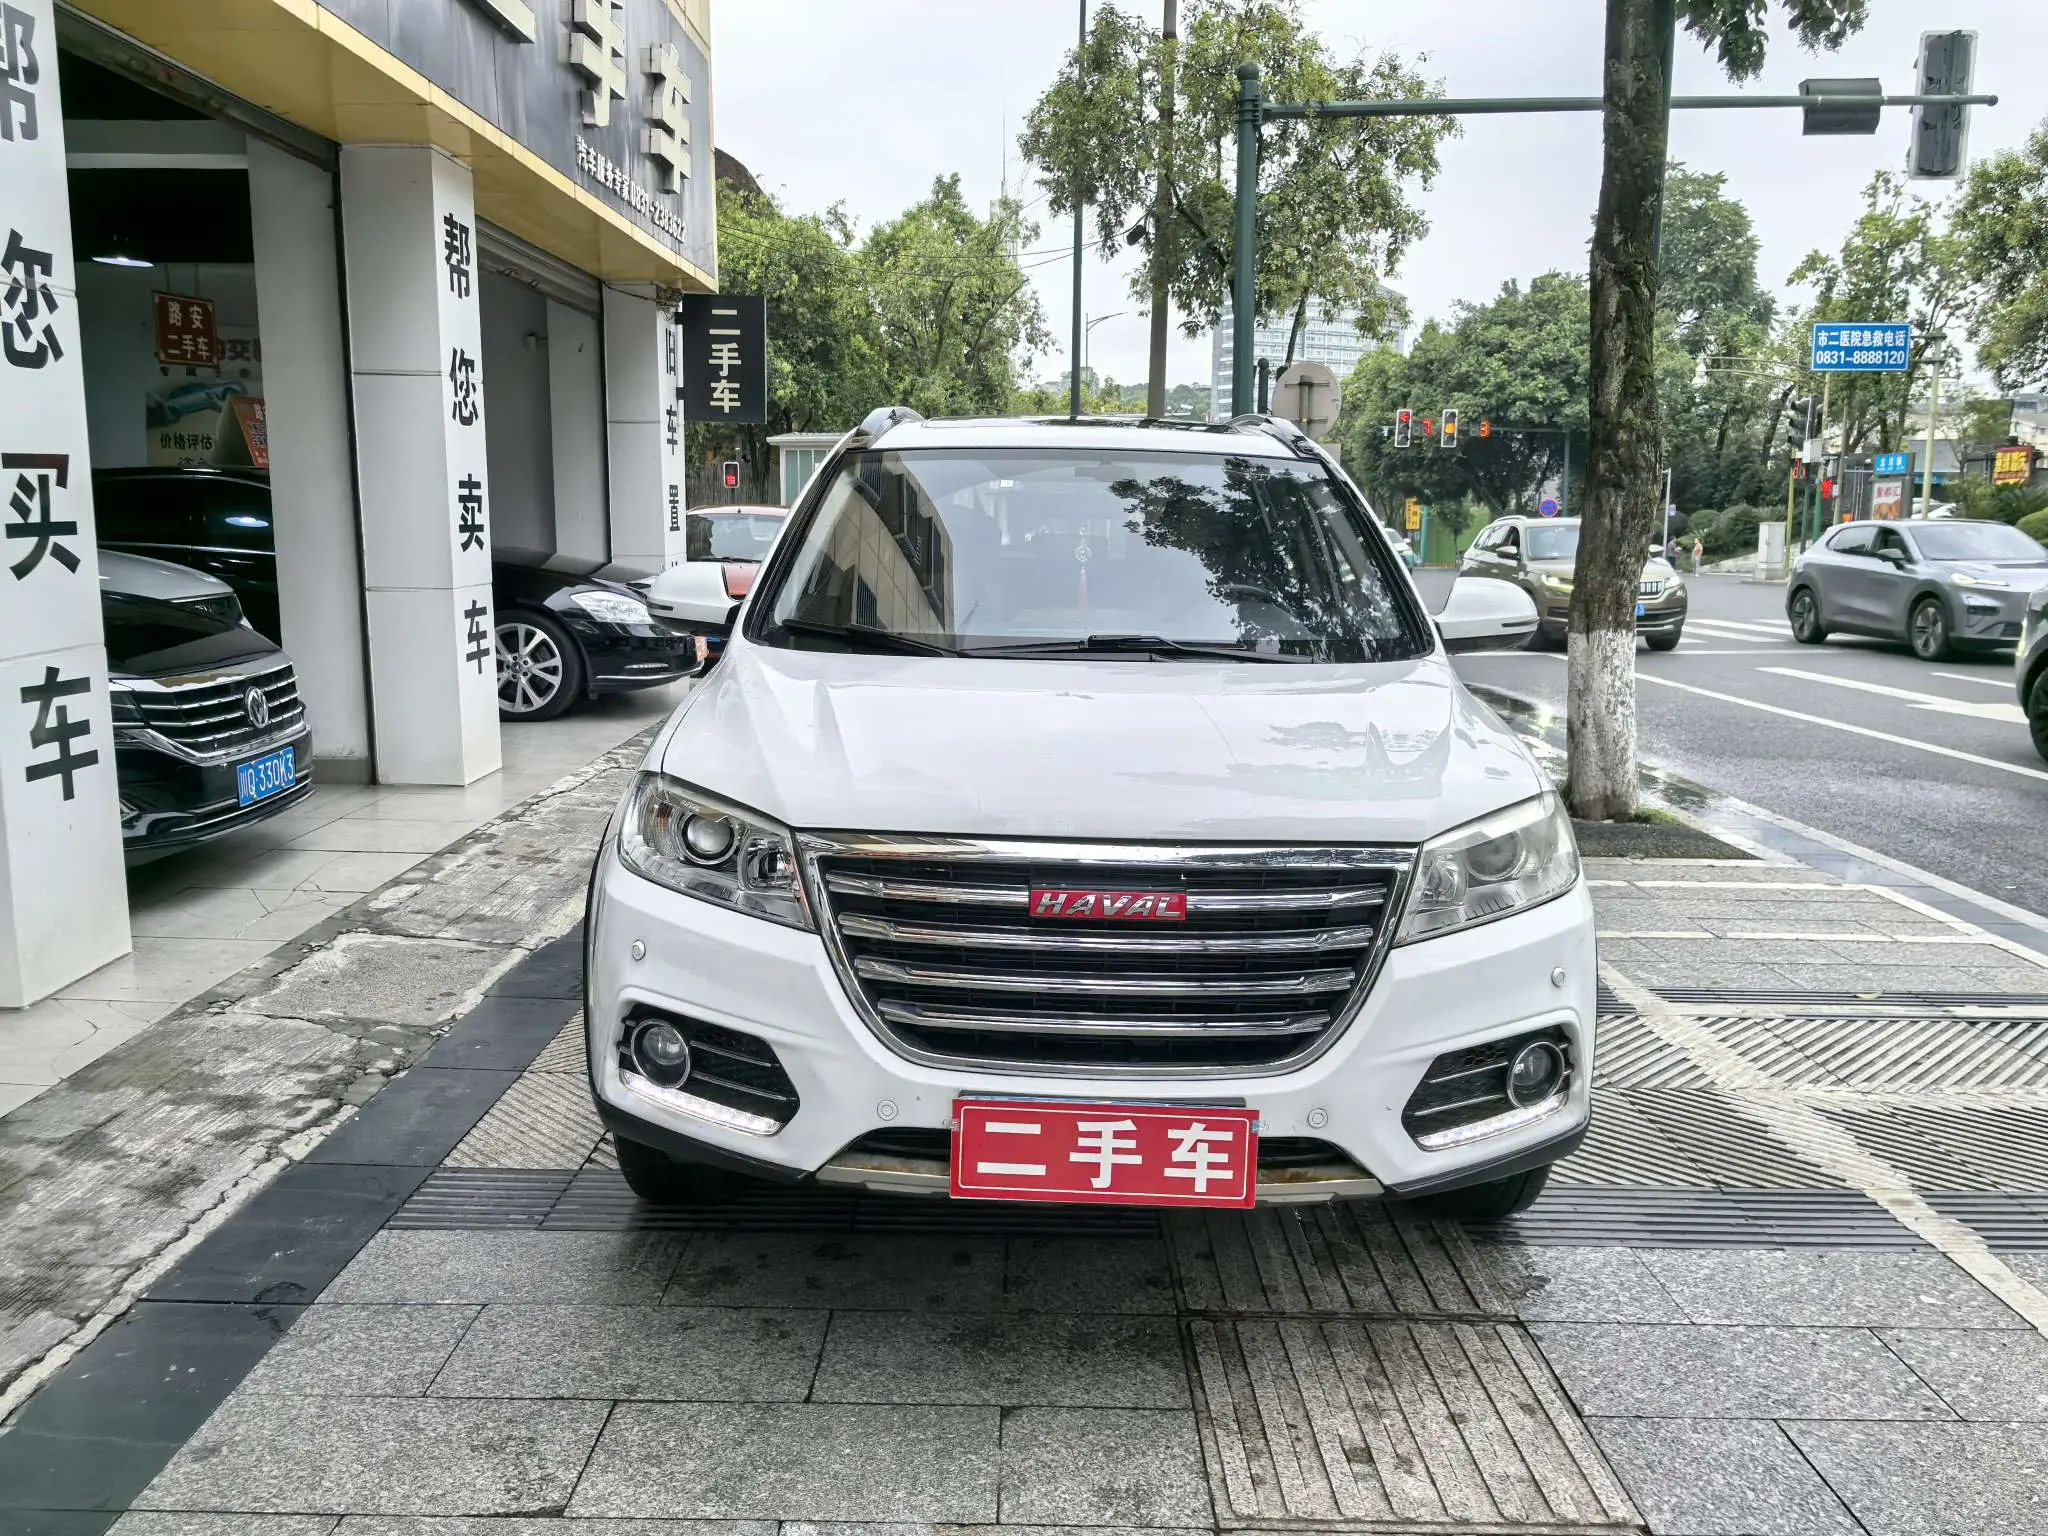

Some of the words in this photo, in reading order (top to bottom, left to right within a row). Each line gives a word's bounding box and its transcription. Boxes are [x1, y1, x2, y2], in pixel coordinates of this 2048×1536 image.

[576, 135, 630, 201] 汽车服务专家
[168, 334, 209, 360] 二手车
[1817, 330, 1906, 347] 市二医院急救电话
[709, 309, 741, 413] 二手车
[1816, 350, 1905, 364] 0831-8888120
[160, 433, 213, 450] 价格评估
[443, 213, 491, 675] 帮您卖车
[1036, 893, 1182, 918] HAVAL
[976, 1119, 1234, 1193] 二手车
